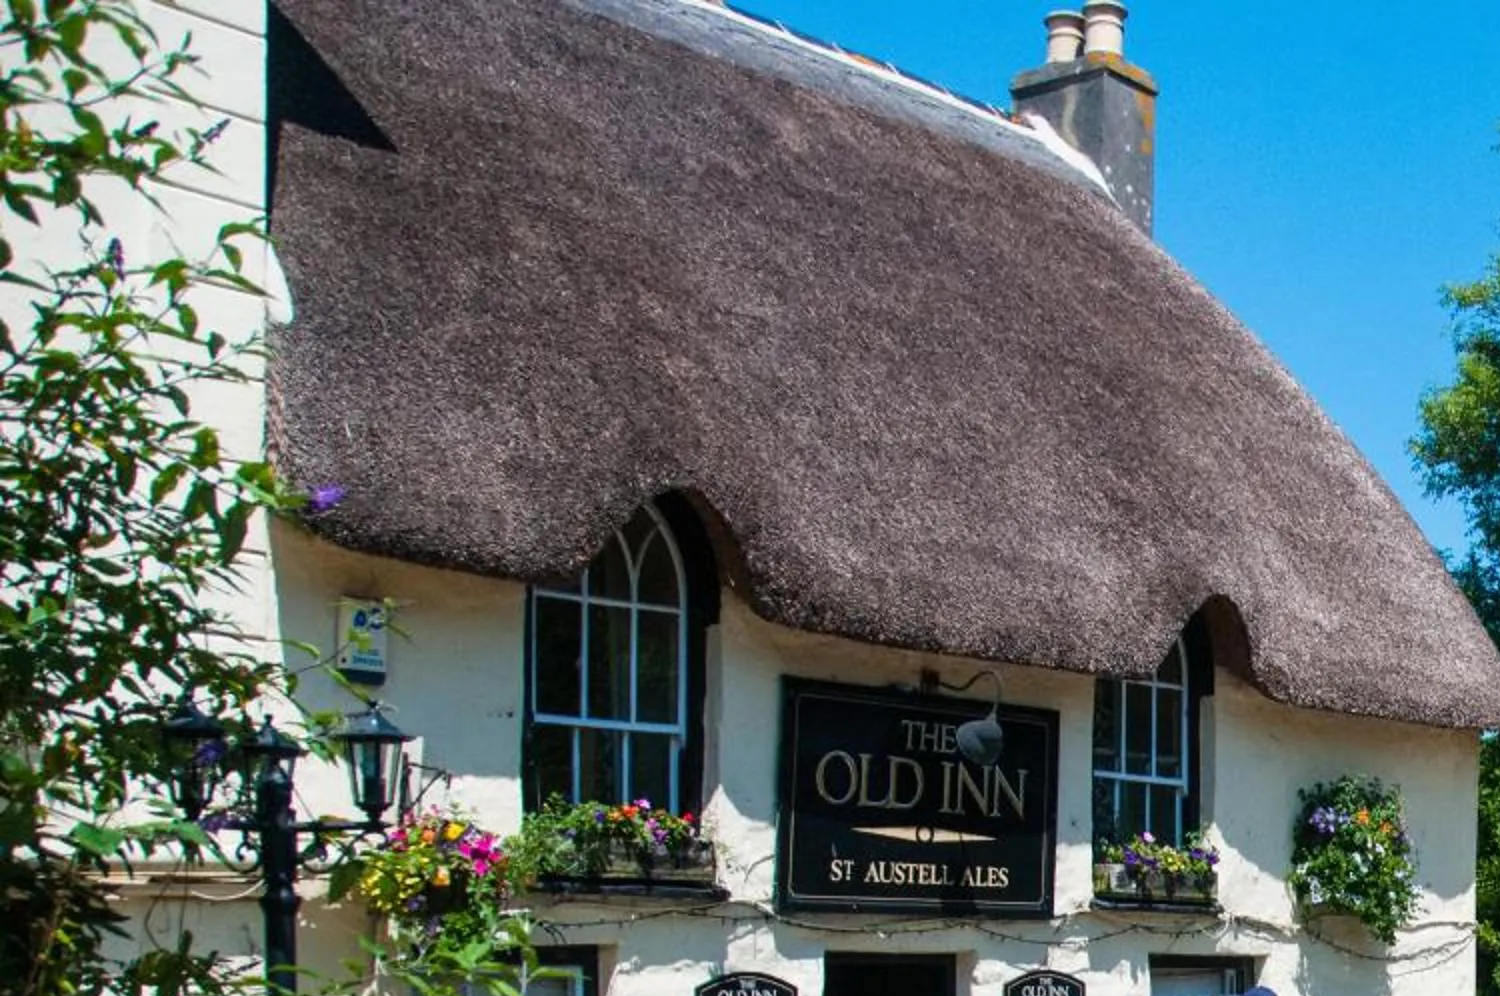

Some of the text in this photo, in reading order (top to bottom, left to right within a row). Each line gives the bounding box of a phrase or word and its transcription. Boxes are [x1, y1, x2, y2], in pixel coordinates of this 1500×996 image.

[902, 720, 957, 752] THE
[815, 750, 1029, 821] OLD INN
[864, 860, 955, 886] AUSTELL
[961, 866, 1009, 888] ALES
